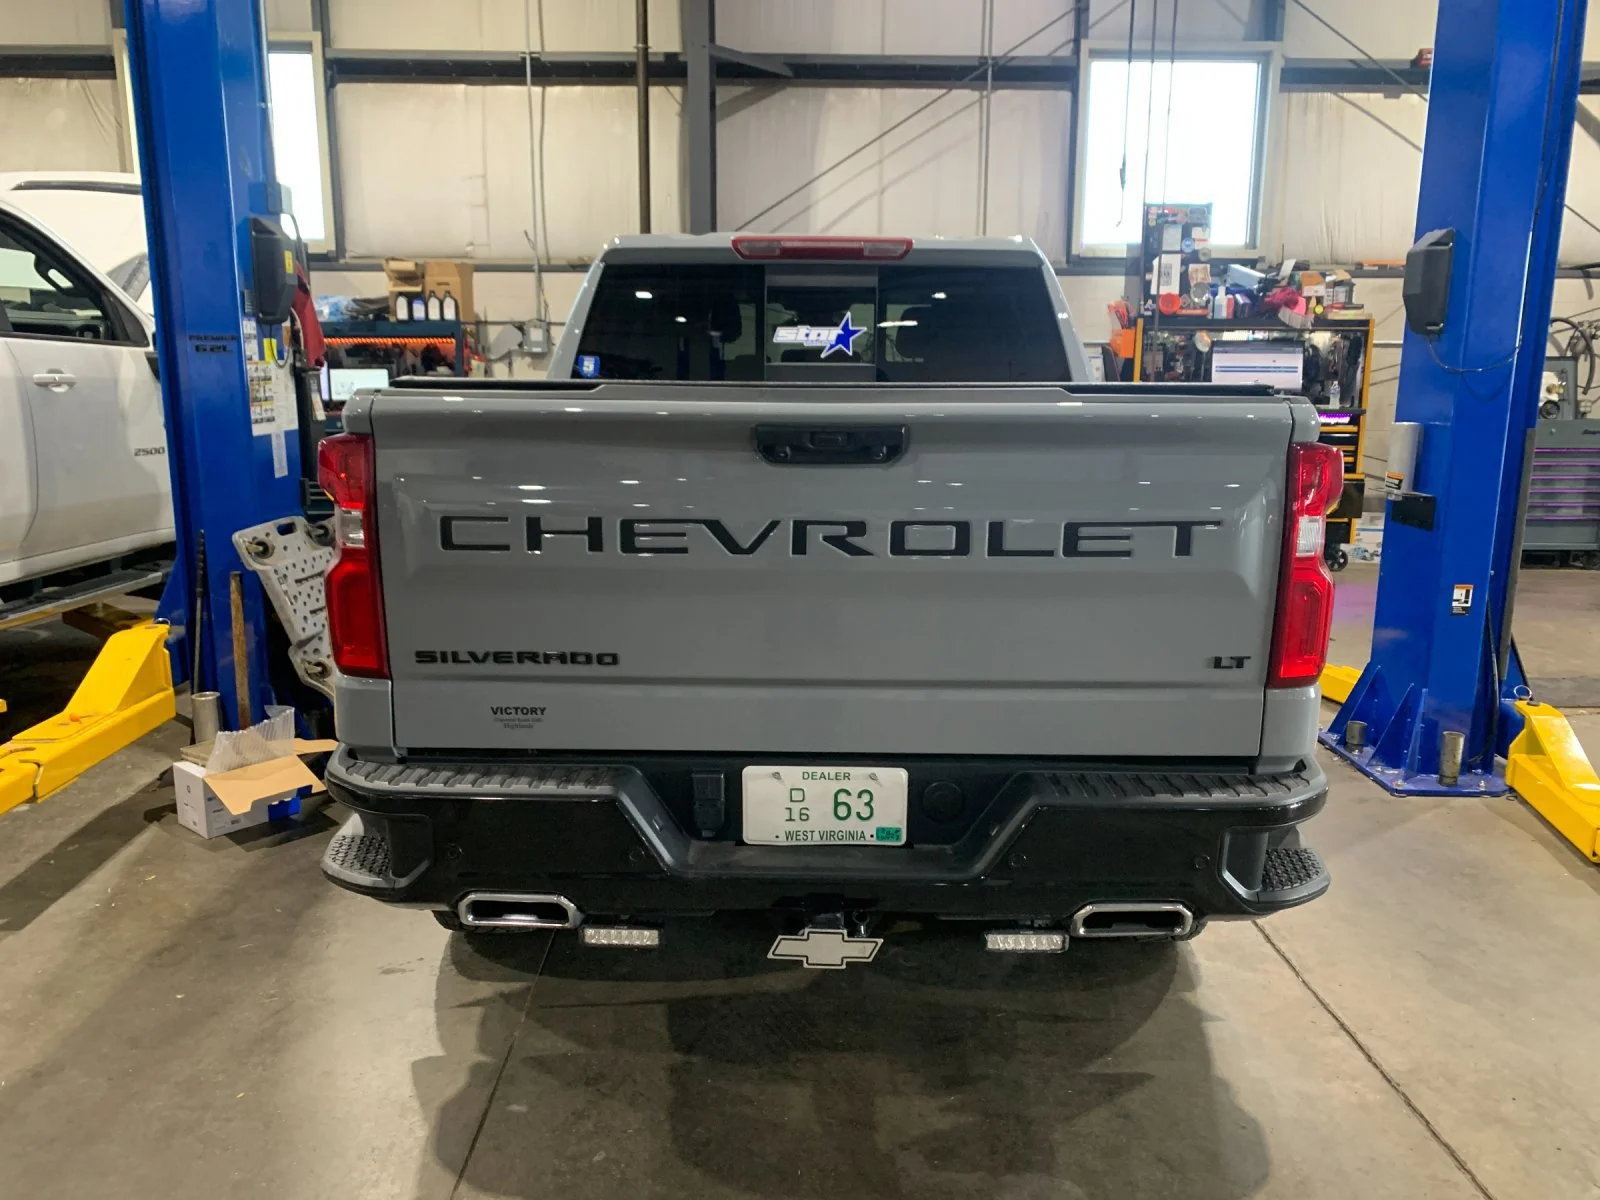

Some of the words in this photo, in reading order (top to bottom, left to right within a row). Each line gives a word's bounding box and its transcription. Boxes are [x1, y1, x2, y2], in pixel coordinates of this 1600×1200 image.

[134, 446, 165, 457] 2500
[440, 516, 1221, 557] CHEVROLET
[415, 650, 619, 666] SILVERADO
[1213, 655, 1251, 669] LT
[490, 706, 547, 716] VICTORY
[802, 771, 851, 781] DEALER
[789, 788, 805, 803] D
[833, 788, 874, 821] 63
[785, 807, 810, 822] 16
[785, 830, 816, 841] WEST
[818, 830, 867, 841] VIRGINIA
